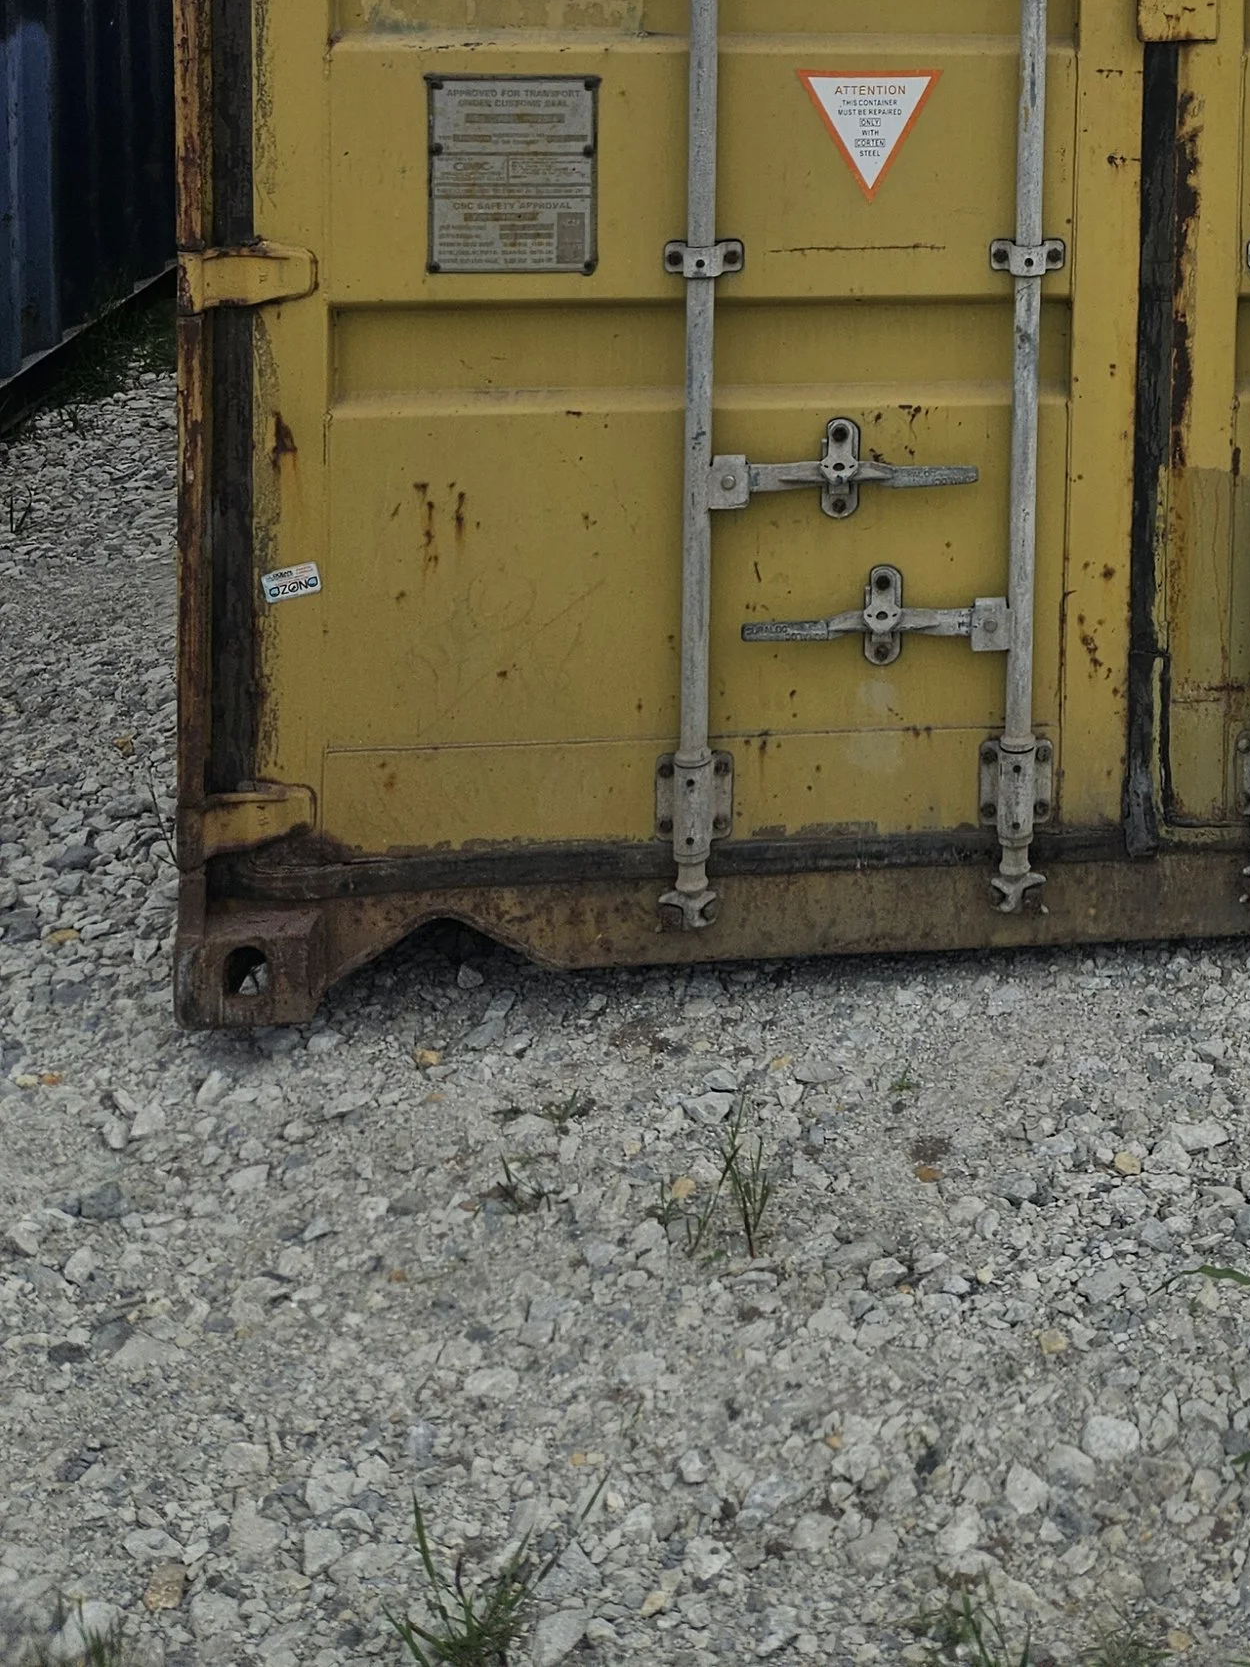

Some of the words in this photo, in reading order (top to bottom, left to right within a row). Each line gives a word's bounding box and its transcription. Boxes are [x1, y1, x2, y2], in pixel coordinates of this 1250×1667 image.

[834, 85, 906, 96] ATTENTION
[868, 108, 902, 116] REPAIRED
[860, 119, 880, 127] ONLY
[855, 139, 885, 147] CORTEN
